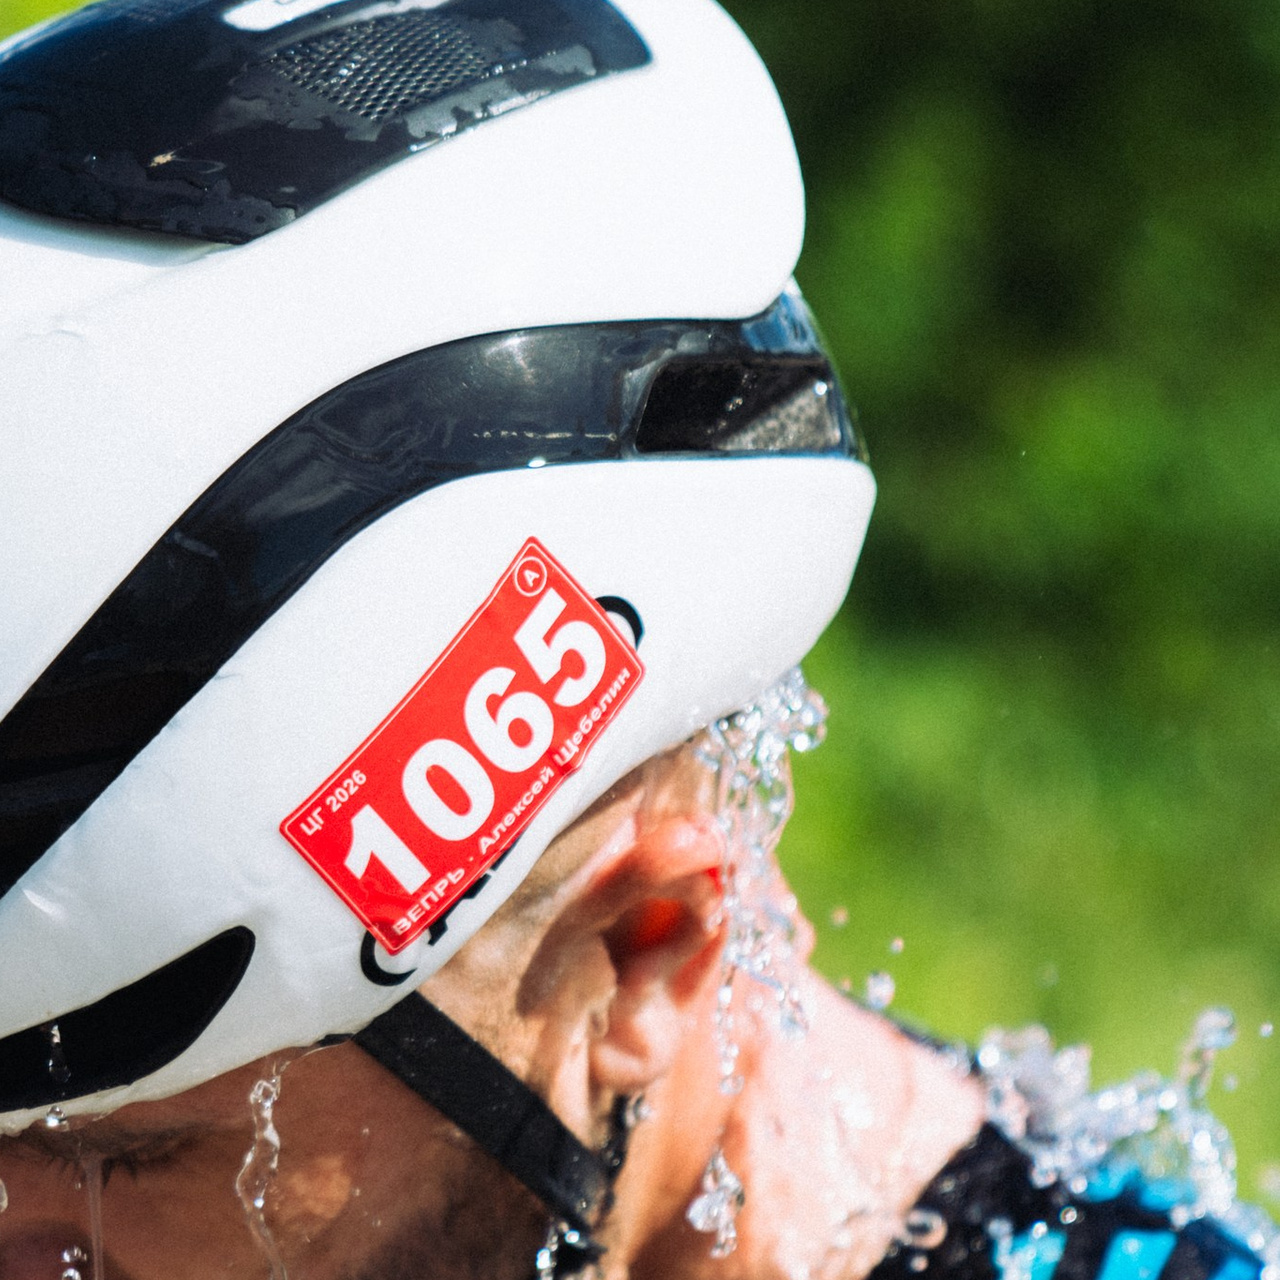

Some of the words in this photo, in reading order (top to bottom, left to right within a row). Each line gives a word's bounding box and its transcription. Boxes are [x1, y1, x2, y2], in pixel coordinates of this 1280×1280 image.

[300, 806, 324, 836] ЦГ
[325, 769, 367, 813] 2026
[344, 587, 607, 896] 1065
[392, 867, 466, 936] ВЕПРЬ
[477, 766, 556, 855] Алексей
[554, 667, 631, 766] Щебелин
